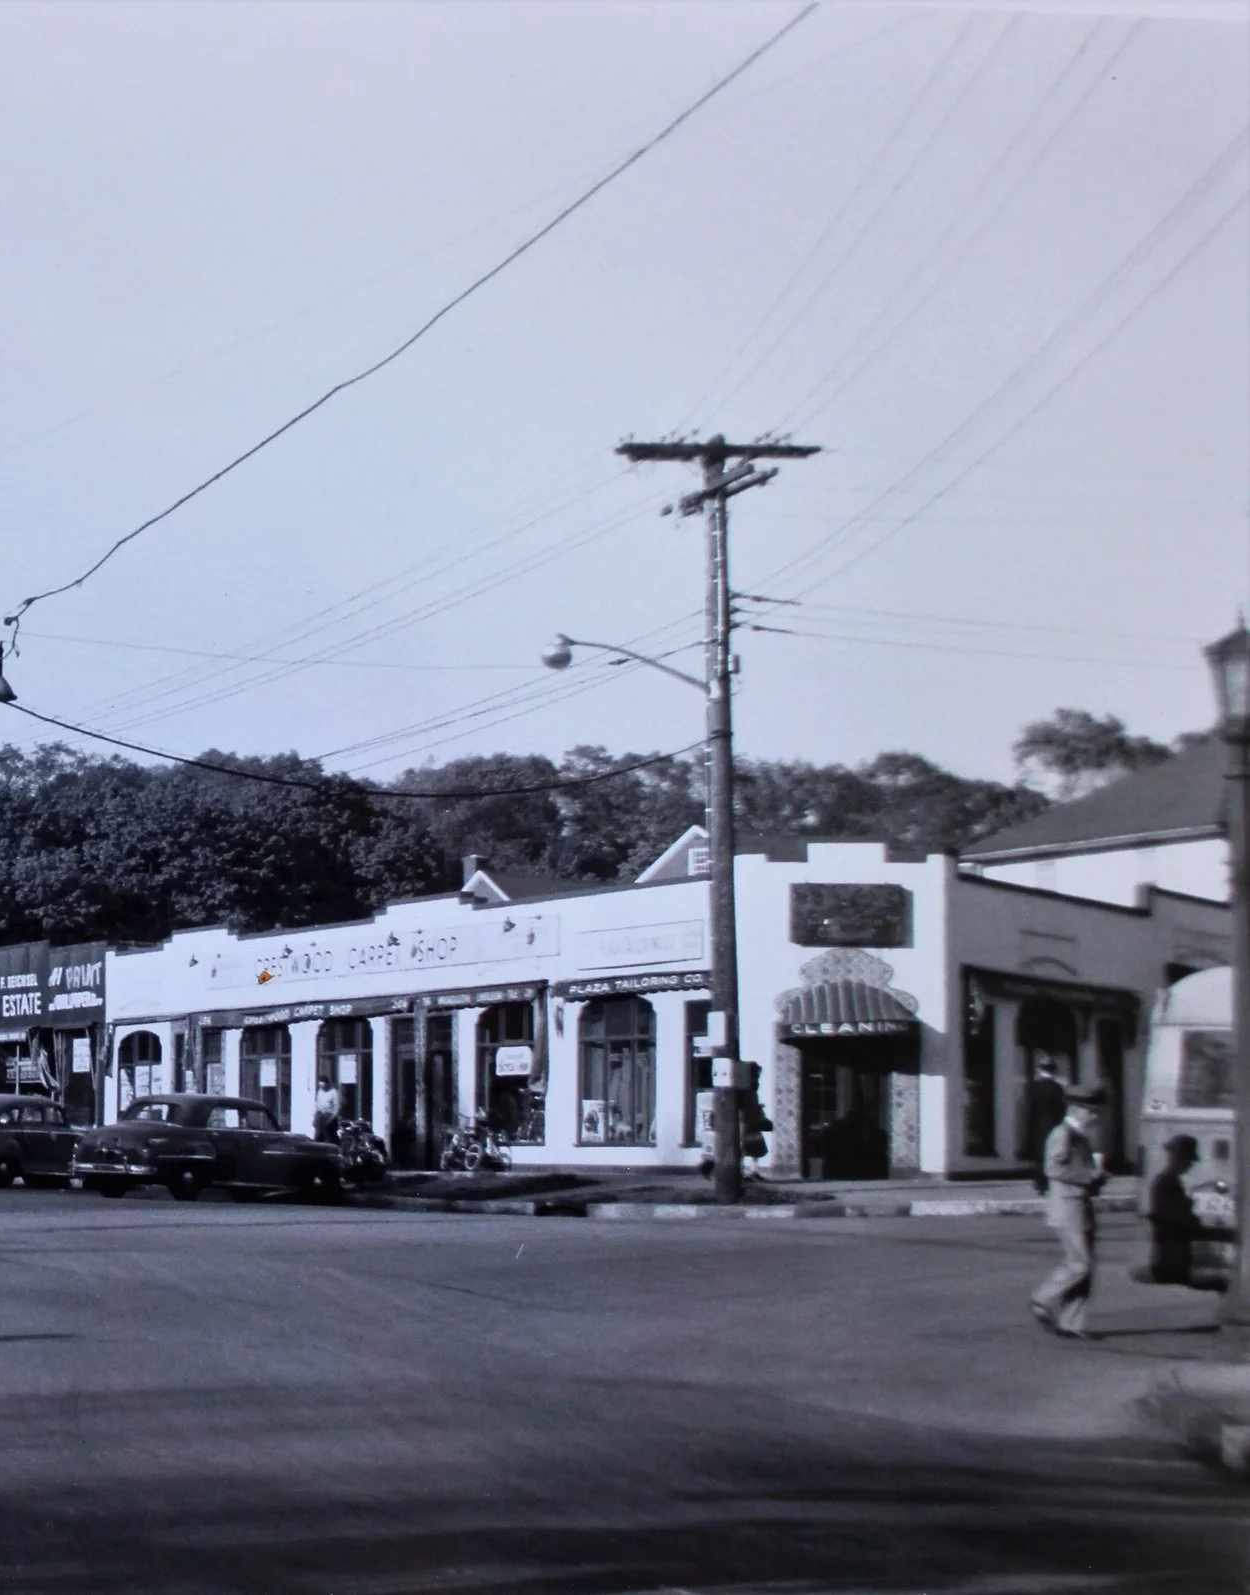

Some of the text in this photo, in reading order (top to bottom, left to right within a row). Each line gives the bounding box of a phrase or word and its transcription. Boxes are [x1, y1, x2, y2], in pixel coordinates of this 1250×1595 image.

[350, 943, 400, 969] CARPET
[417, 936, 458, 962] SHOP
[569, 982, 610, 994] PLAZA
[615, 975, 679, 990] TAILORING
[2, 992, 42, 1017] ESTATE
[790, 1022, 910, 1034] CLEANING
